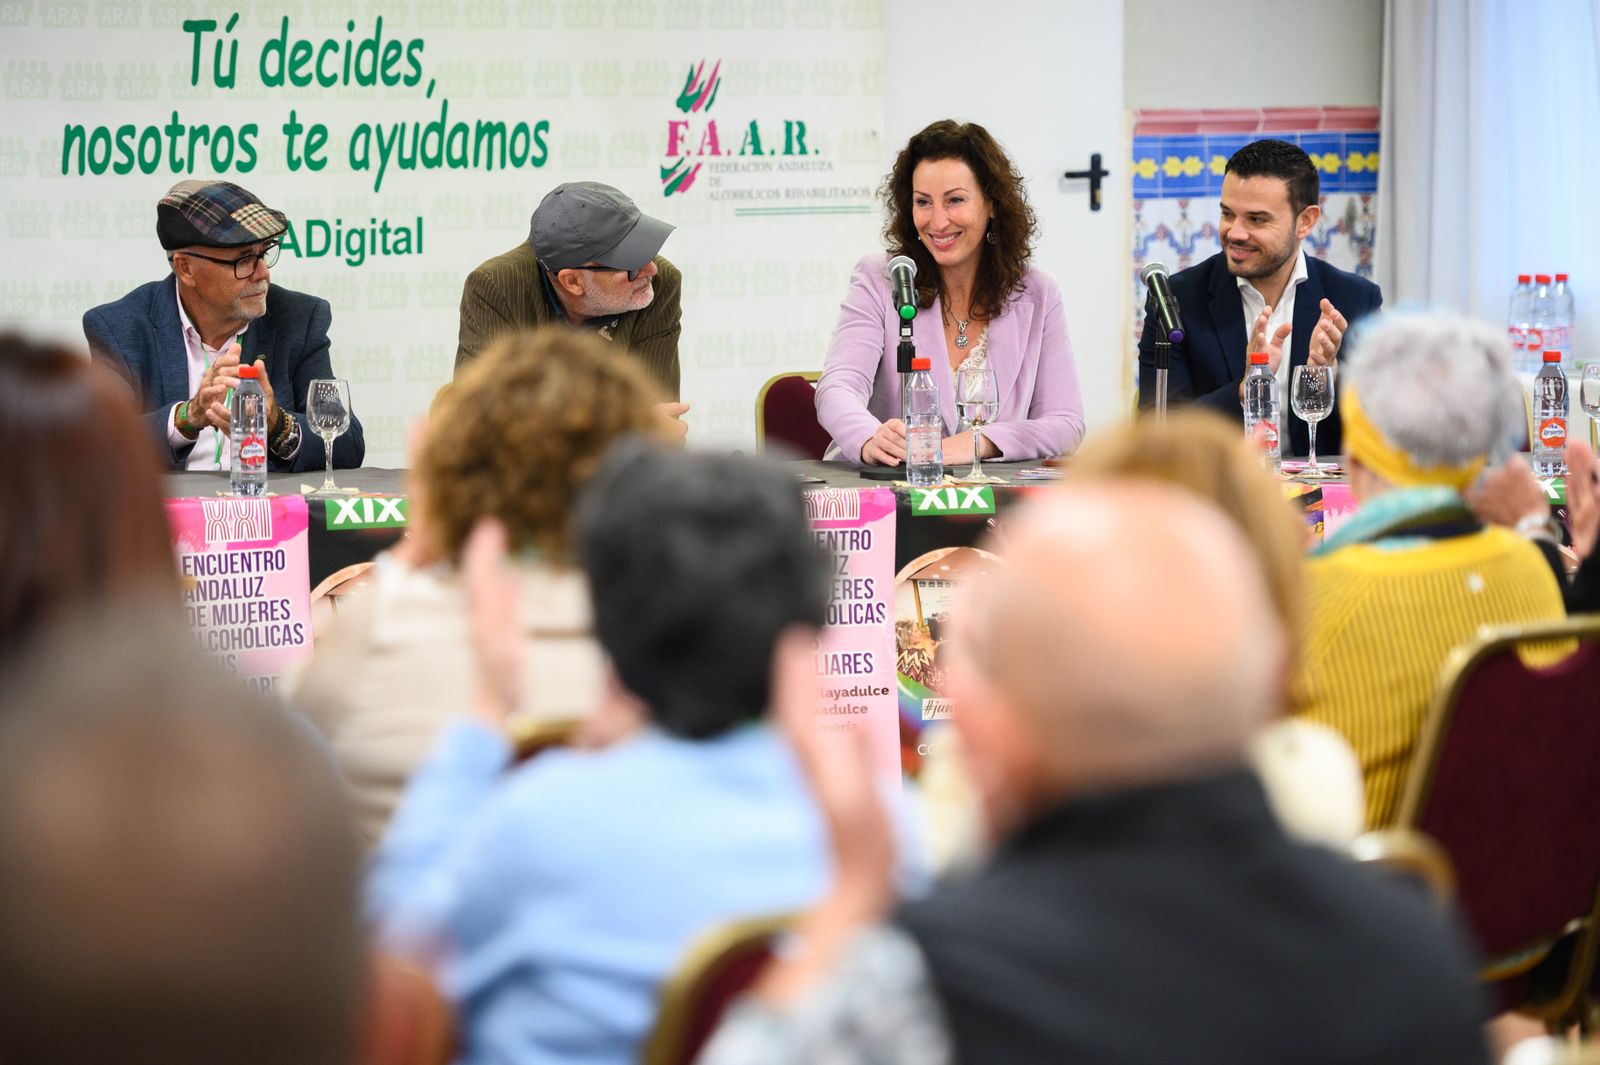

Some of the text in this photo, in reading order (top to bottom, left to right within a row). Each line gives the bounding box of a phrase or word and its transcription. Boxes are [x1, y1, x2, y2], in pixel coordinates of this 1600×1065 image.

[2, 6, 26, 22] RA
[46, 8, 81, 25] ARA
[101, 8, 136, 24] ARA
[183, 12, 436, 99] Tú decides,
[8, 78, 45, 96] ARA
[65, 79, 99, 97] ARA
[119, 80, 153, 97] ARA
[61, 98, 550, 193] nosotros te ayudamos
[777, 160, 834, 172] ANDALUZA
[708, 176, 721, 187] DE
[279, 217, 423, 267] ADigital
[918, 487, 990, 511] XIX
[201, 500, 273, 544] XXI
[333, 498, 406, 525] XIX
[812, 529, 872, 551] ENTRO
[182, 549, 286, 577] ENCUENTRO
[212, 598, 291, 627] MUJERES
[815, 652, 874, 676] LIARES
[821, 685, 890, 701] layadulce
